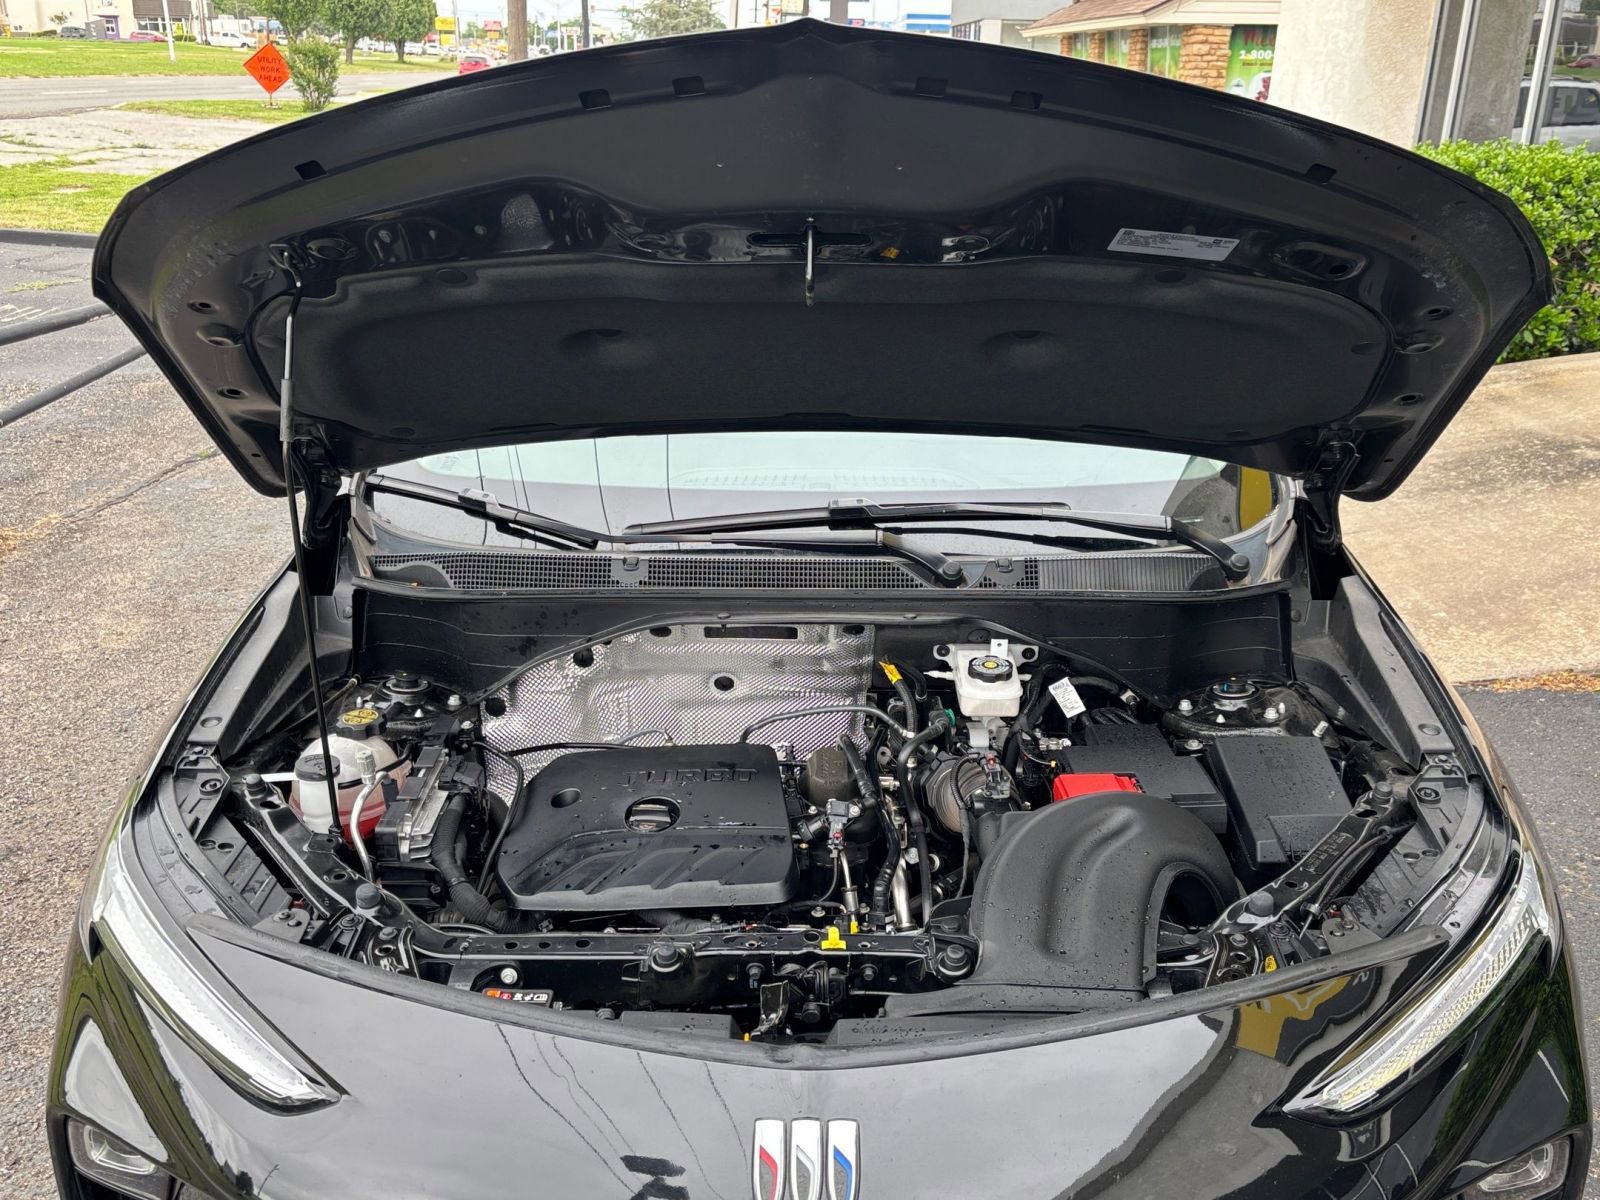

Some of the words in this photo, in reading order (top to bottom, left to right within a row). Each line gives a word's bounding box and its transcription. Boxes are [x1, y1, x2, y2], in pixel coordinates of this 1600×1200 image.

[257, 56, 282, 64] UTILITY
[260, 66, 281, 74] WORK
[259, 74, 282, 82] AHEAD
[621, 768, 757, 784] TURBO
